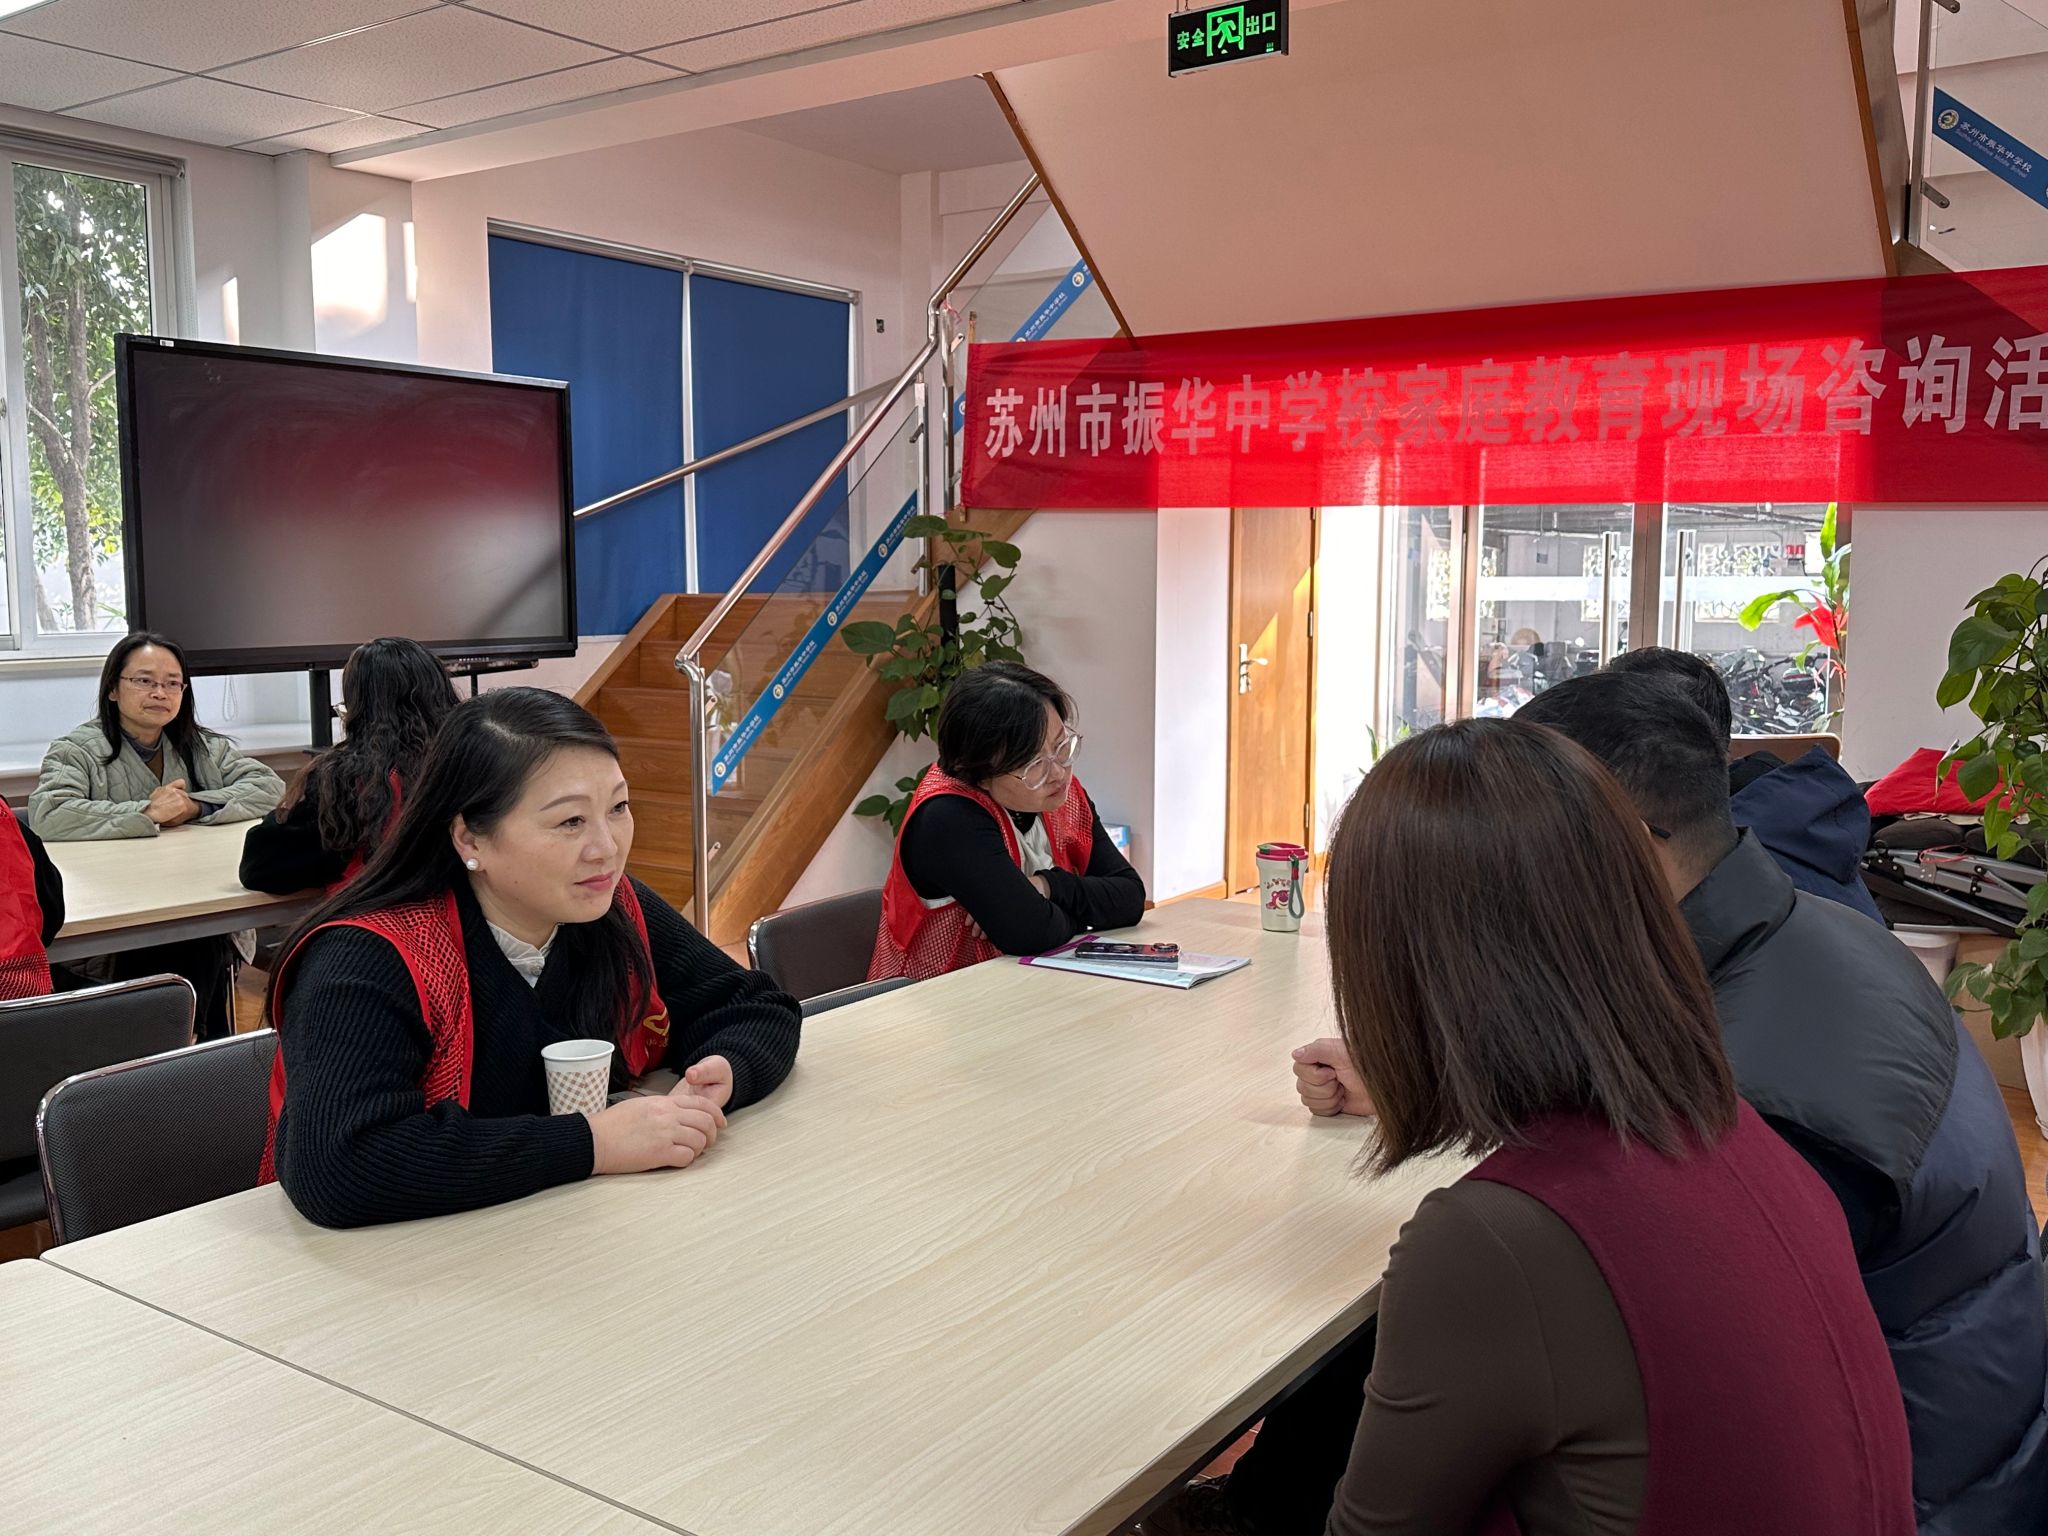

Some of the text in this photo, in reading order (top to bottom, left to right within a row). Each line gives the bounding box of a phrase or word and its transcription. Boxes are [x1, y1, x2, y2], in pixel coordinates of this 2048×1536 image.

[1177, 11, 1276, 50] 安全 出口
[984, 332, 2048, 459] 苏州市振华中学校家庭教育现场咨询活
